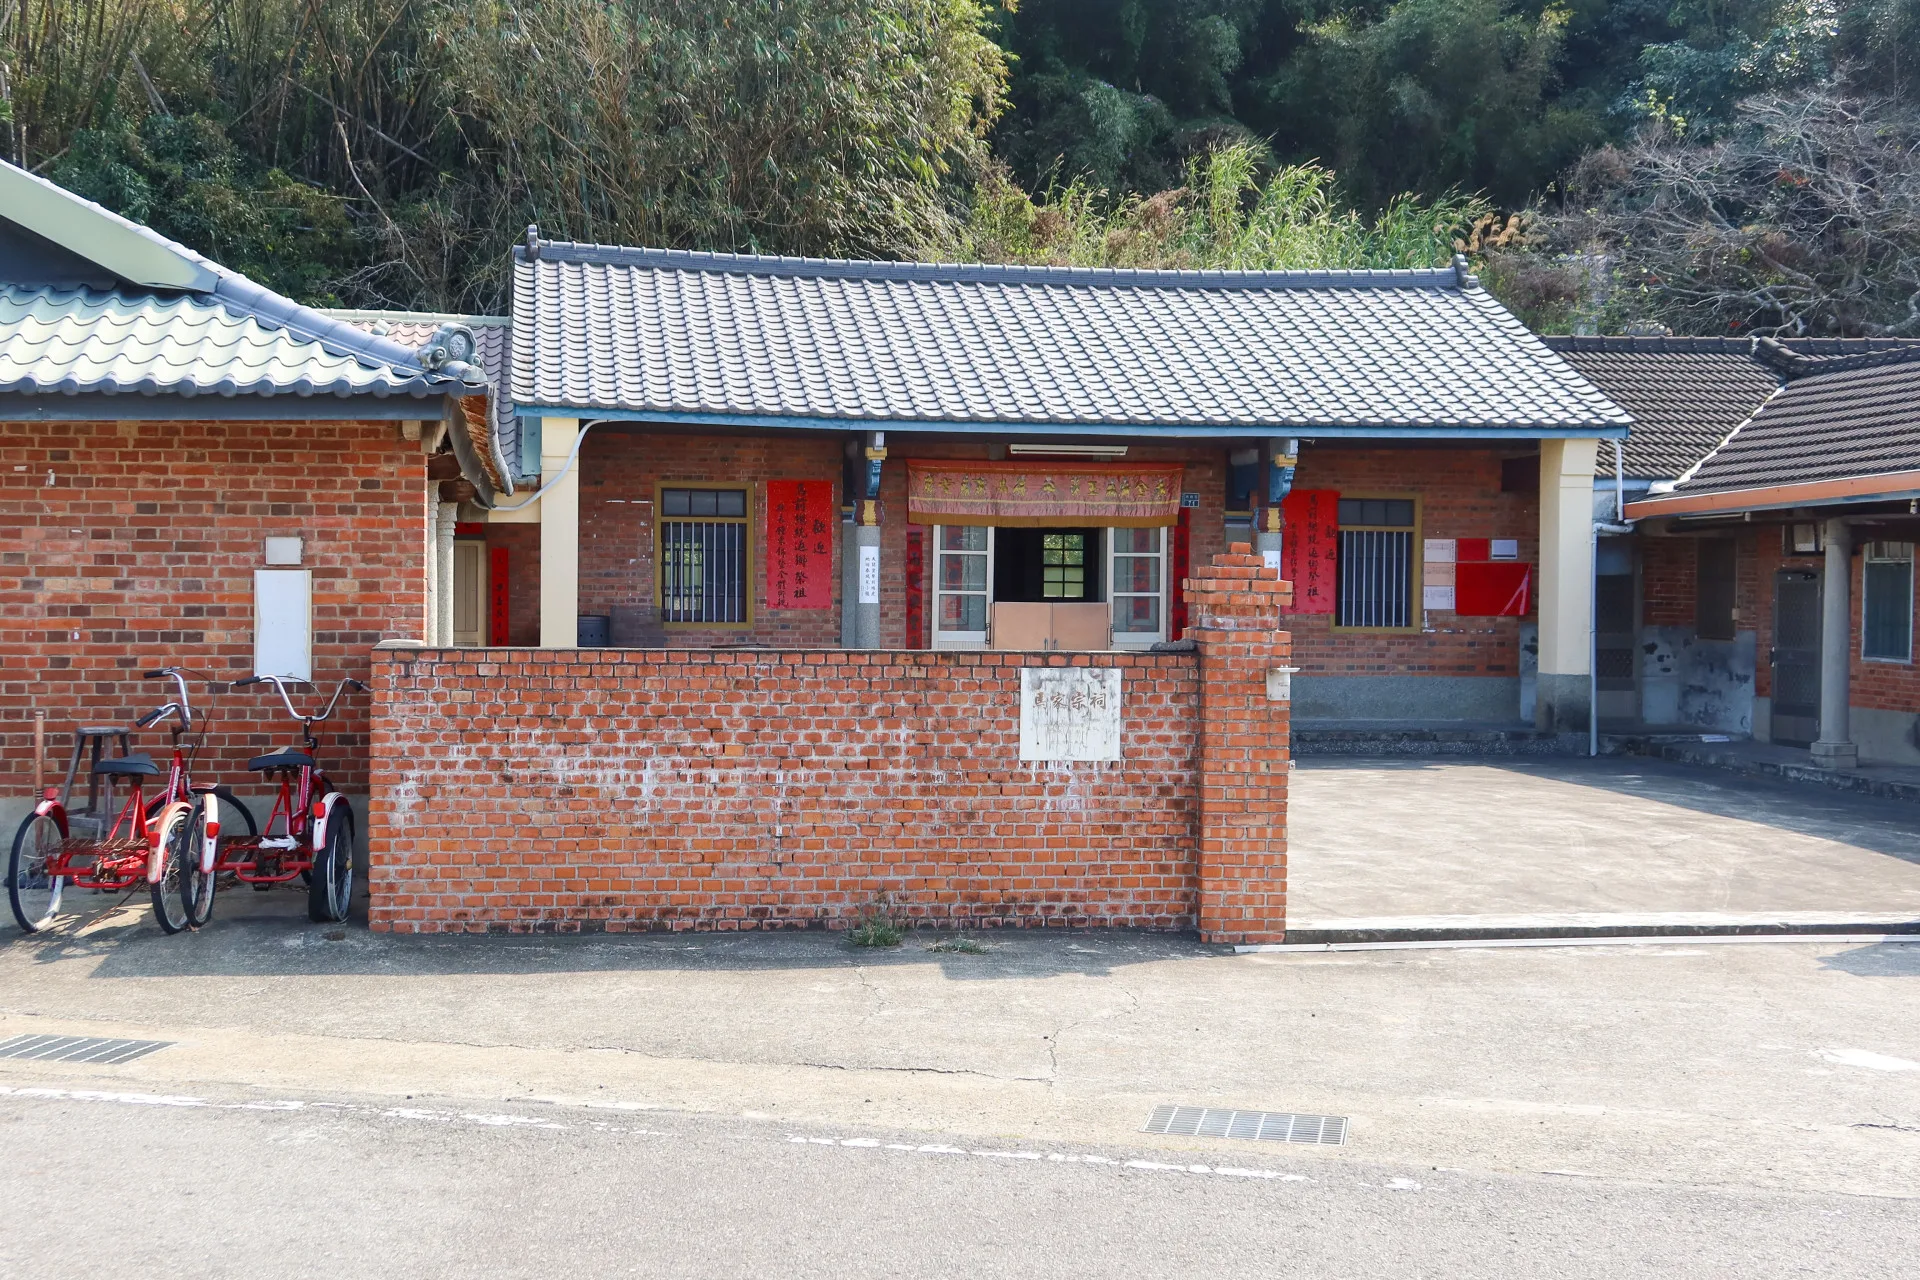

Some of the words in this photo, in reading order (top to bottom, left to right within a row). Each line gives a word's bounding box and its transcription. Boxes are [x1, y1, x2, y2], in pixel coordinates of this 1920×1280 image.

[811, 519, 828, 555] 歡迎
[1033, 691, 1107, 711] 馬家宗祠
